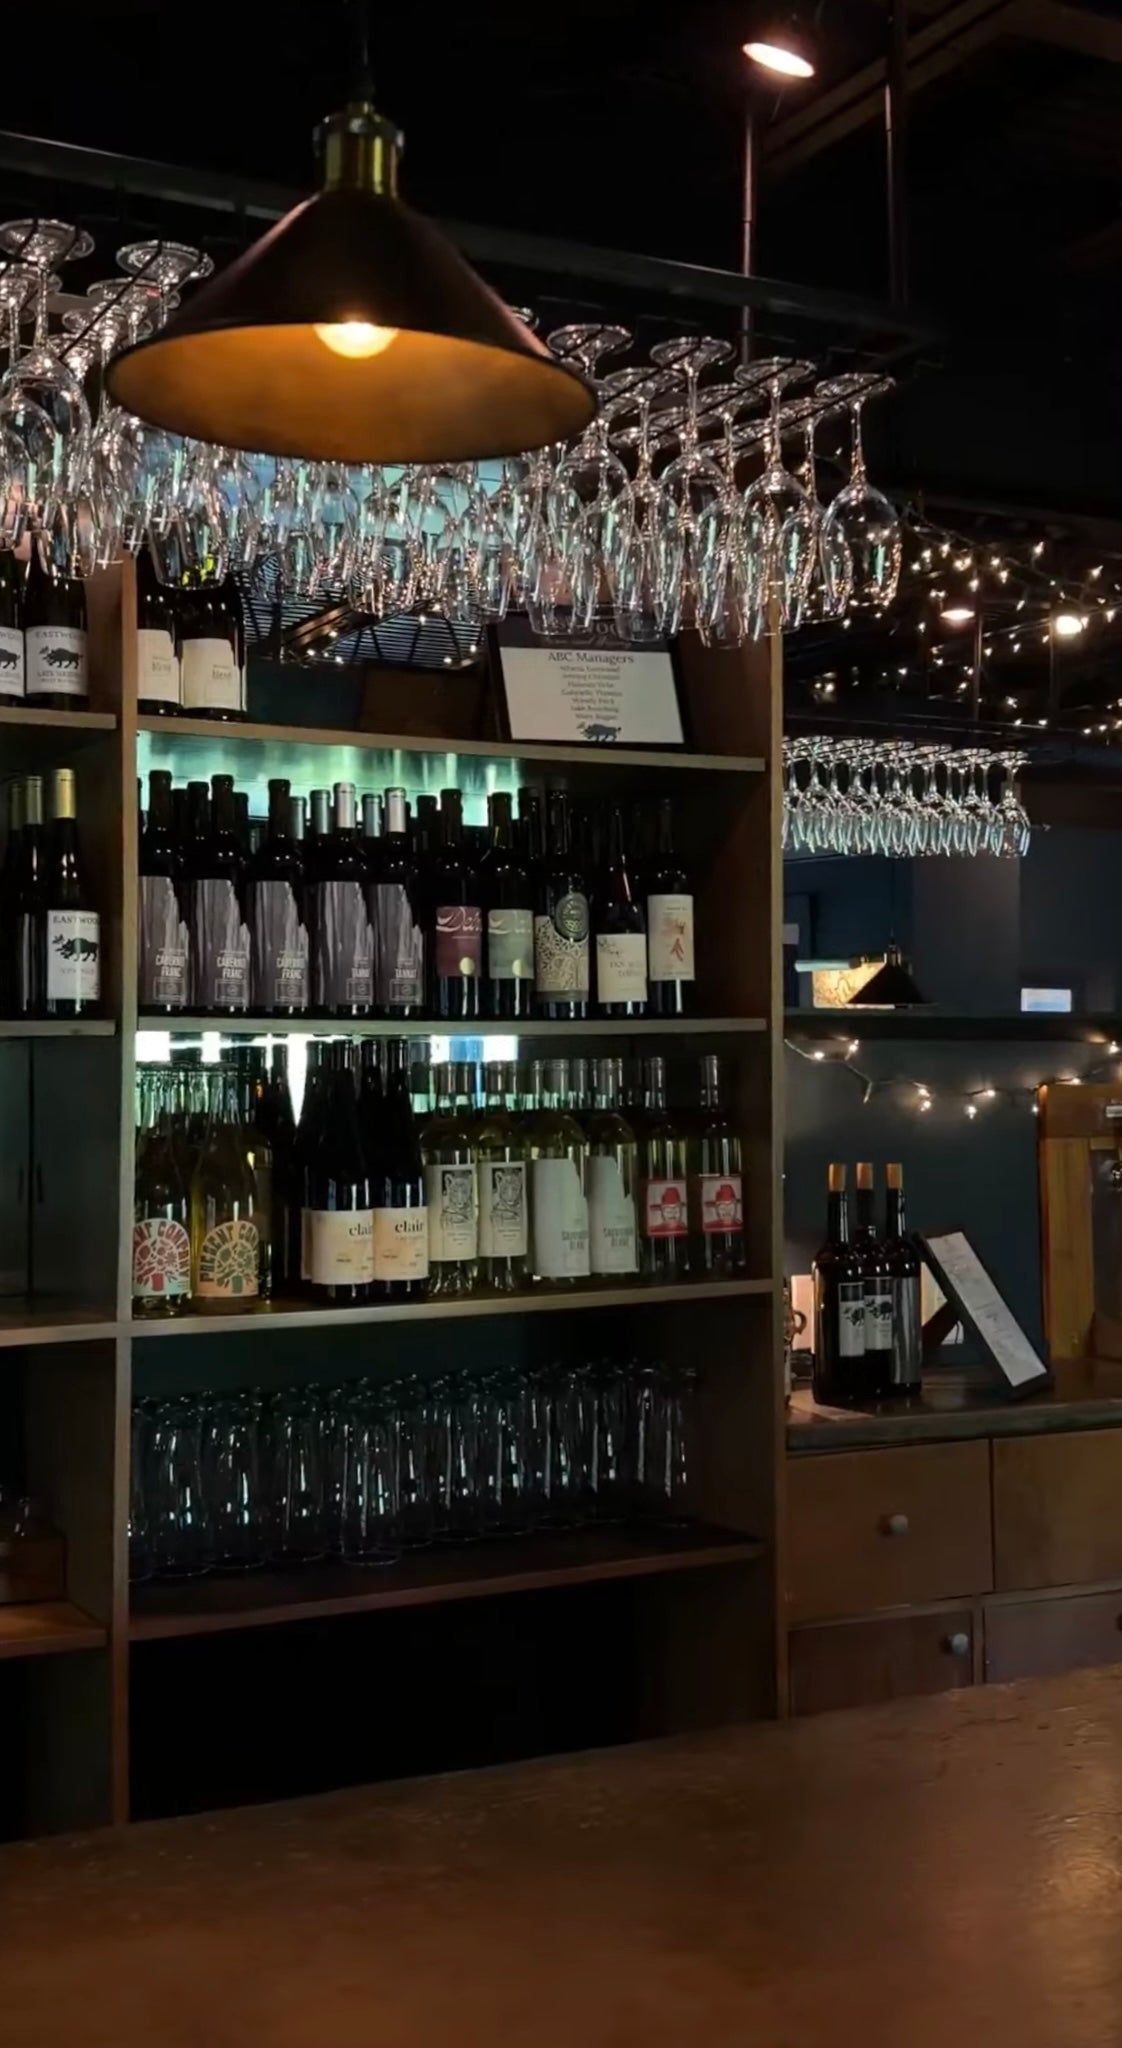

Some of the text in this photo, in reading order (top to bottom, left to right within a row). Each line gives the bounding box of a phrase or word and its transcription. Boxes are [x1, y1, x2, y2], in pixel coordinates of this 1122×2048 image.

[548, 652, 634, 665] ABC Managers
[394, 1219, 424, 1234] clair
